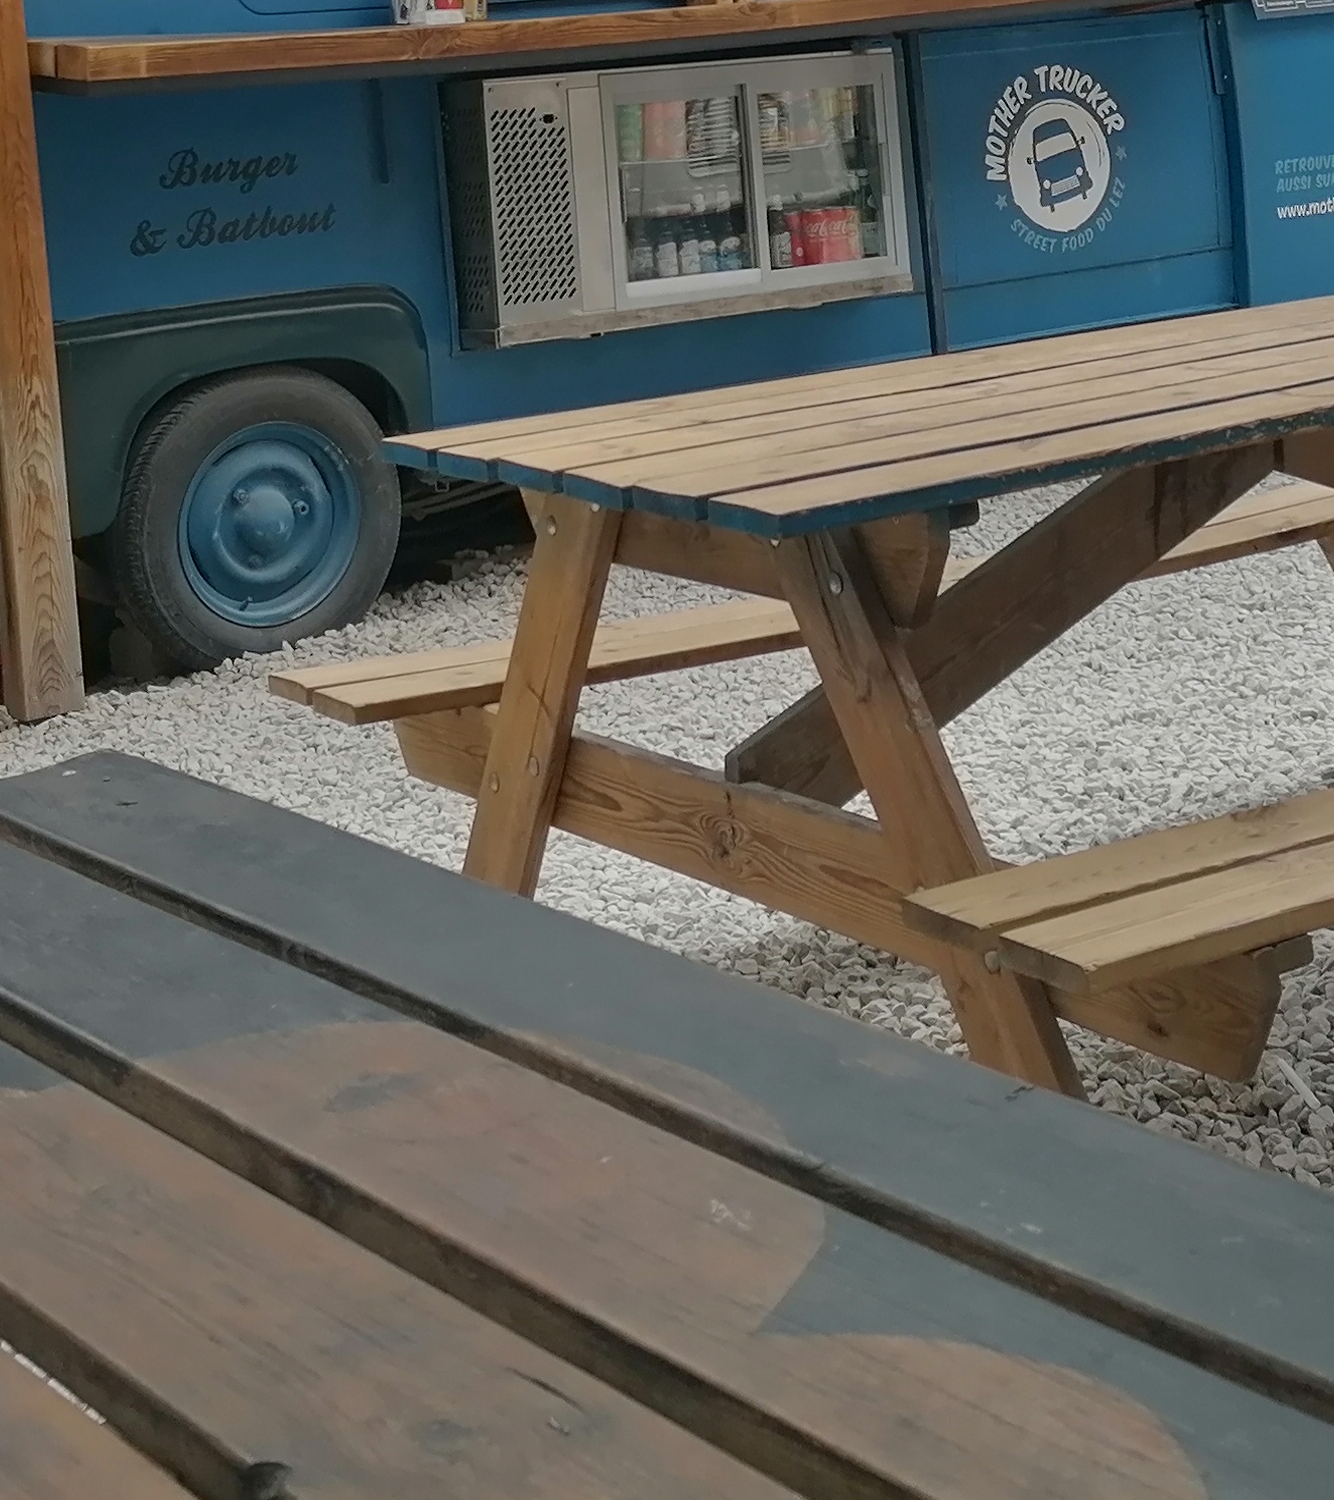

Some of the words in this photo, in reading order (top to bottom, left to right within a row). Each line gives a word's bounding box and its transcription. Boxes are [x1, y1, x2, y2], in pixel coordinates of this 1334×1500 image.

[984, 76, 1033, 181] MOTHER
[1034, 64, 1125, 135] TRUCKER
[159, 148, 299, 194] Burger
[1276, 175, 1311, 193] AUSSI
[129, 219, 167, 257] &
[1010, 218, 1057, 254] STREET
[1061, 227, 1095, 253] FOOD
[1097, 209, 1113, 231] DU
[1112, 177, 1127, 208] LEZ
